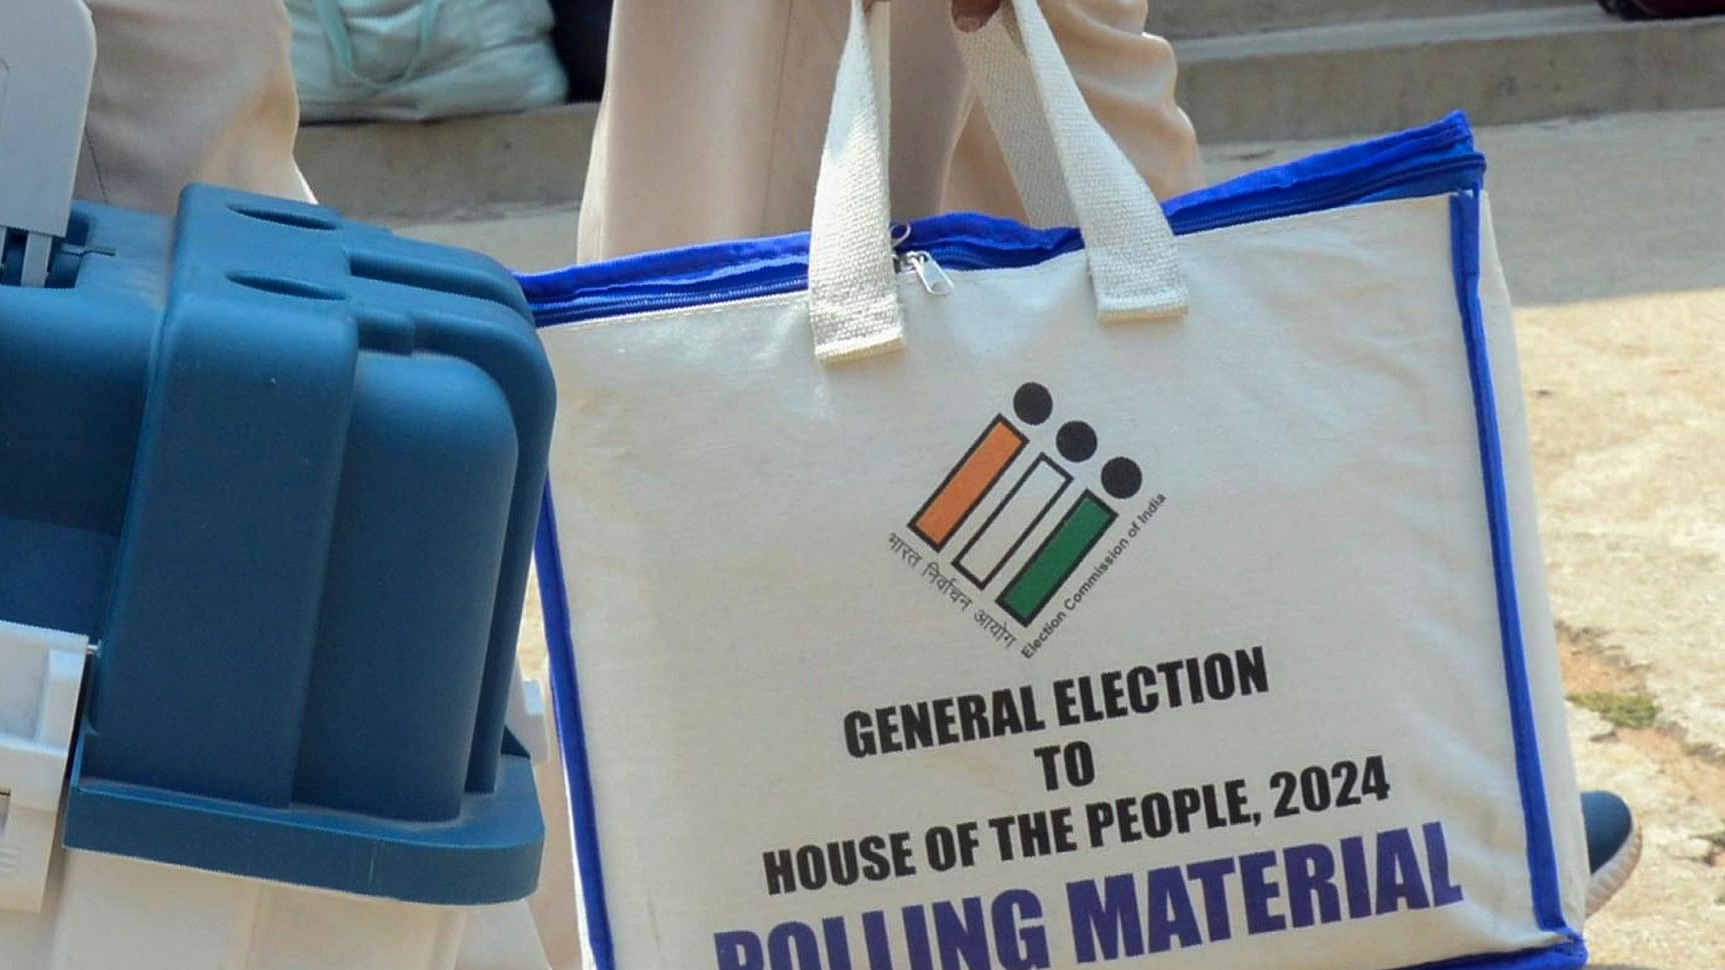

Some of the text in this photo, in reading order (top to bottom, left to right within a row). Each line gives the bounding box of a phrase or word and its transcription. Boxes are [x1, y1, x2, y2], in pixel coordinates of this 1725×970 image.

[888, 532, 1018, 649] भारत निर्वाचन आयोग
[1021, 492, 1167, 660] Election Commission of India
[843, 646, 1269, 759] GENERAL ELECTION
[1033, 740, 1095, 792] TO
[763, 754, 1391, 895] HOUSE OF THE PEOPLE, 2024
[1066, 821, 1464, 965] MATERIAL
